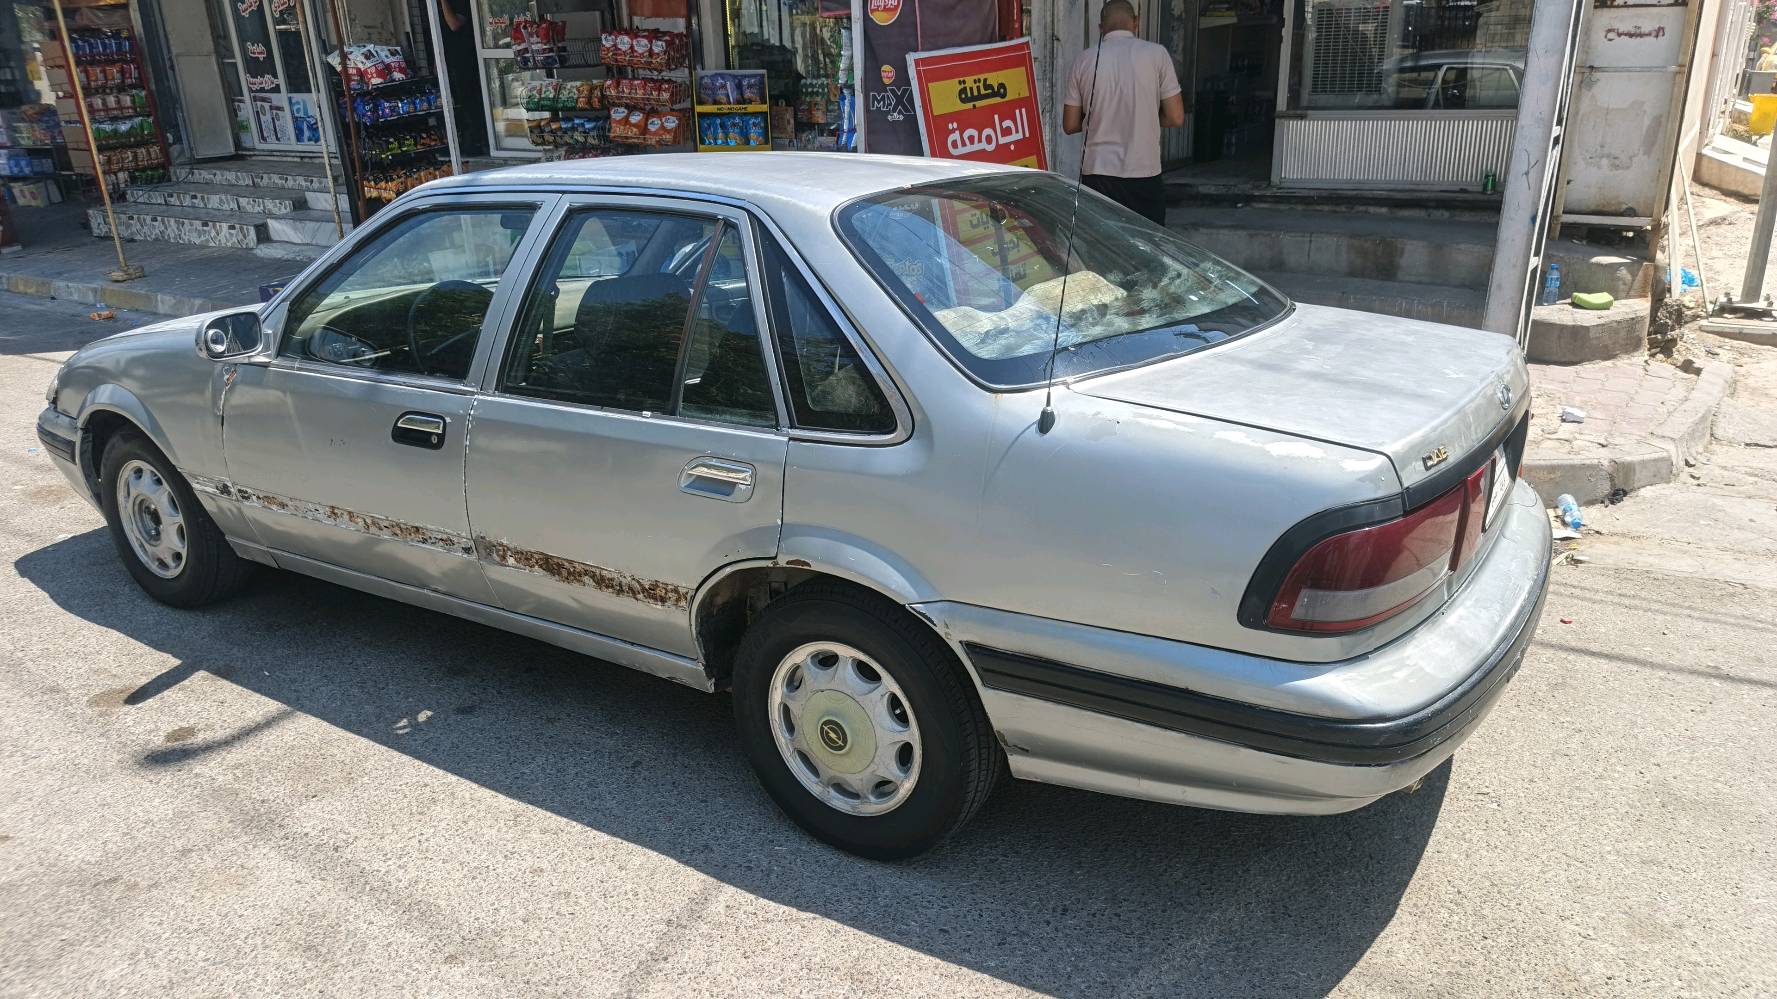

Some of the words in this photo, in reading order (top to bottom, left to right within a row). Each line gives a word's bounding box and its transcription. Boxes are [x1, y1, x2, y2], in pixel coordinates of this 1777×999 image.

[870, 86, 915, 114] MAX
[958, 78, 1008, 109] مكتبة
[947, 108, 1029, 156] الجامعة
